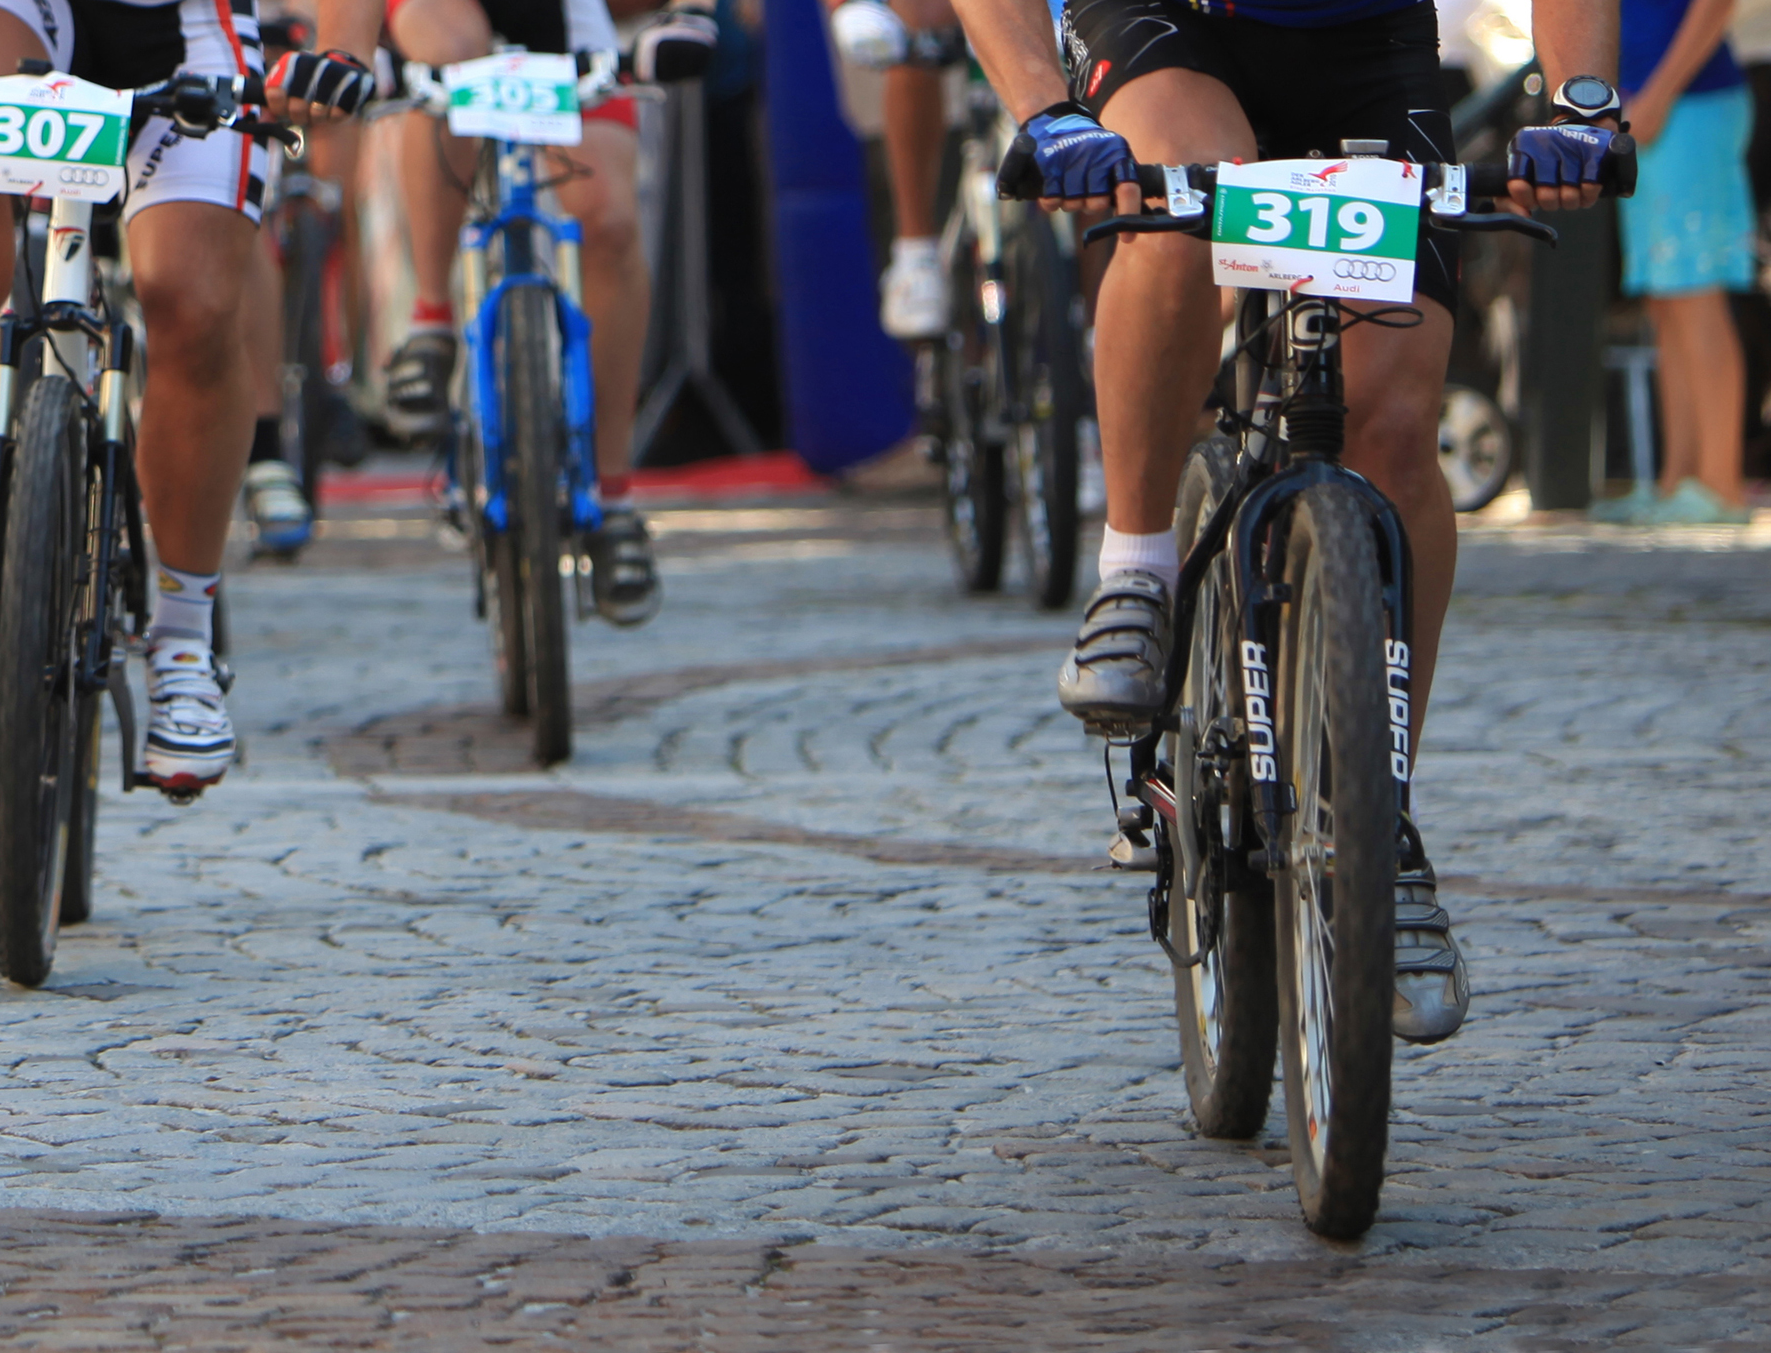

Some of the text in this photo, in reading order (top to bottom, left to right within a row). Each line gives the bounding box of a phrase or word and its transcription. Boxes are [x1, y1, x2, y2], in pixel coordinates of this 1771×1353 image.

[1043, 131, 1116, 158] SHIMANO
[1246, 192, 1384, 251] 319
[1334, 284, 1360, 293] Audi
[1241, 640, 1277, 782] SUPER
